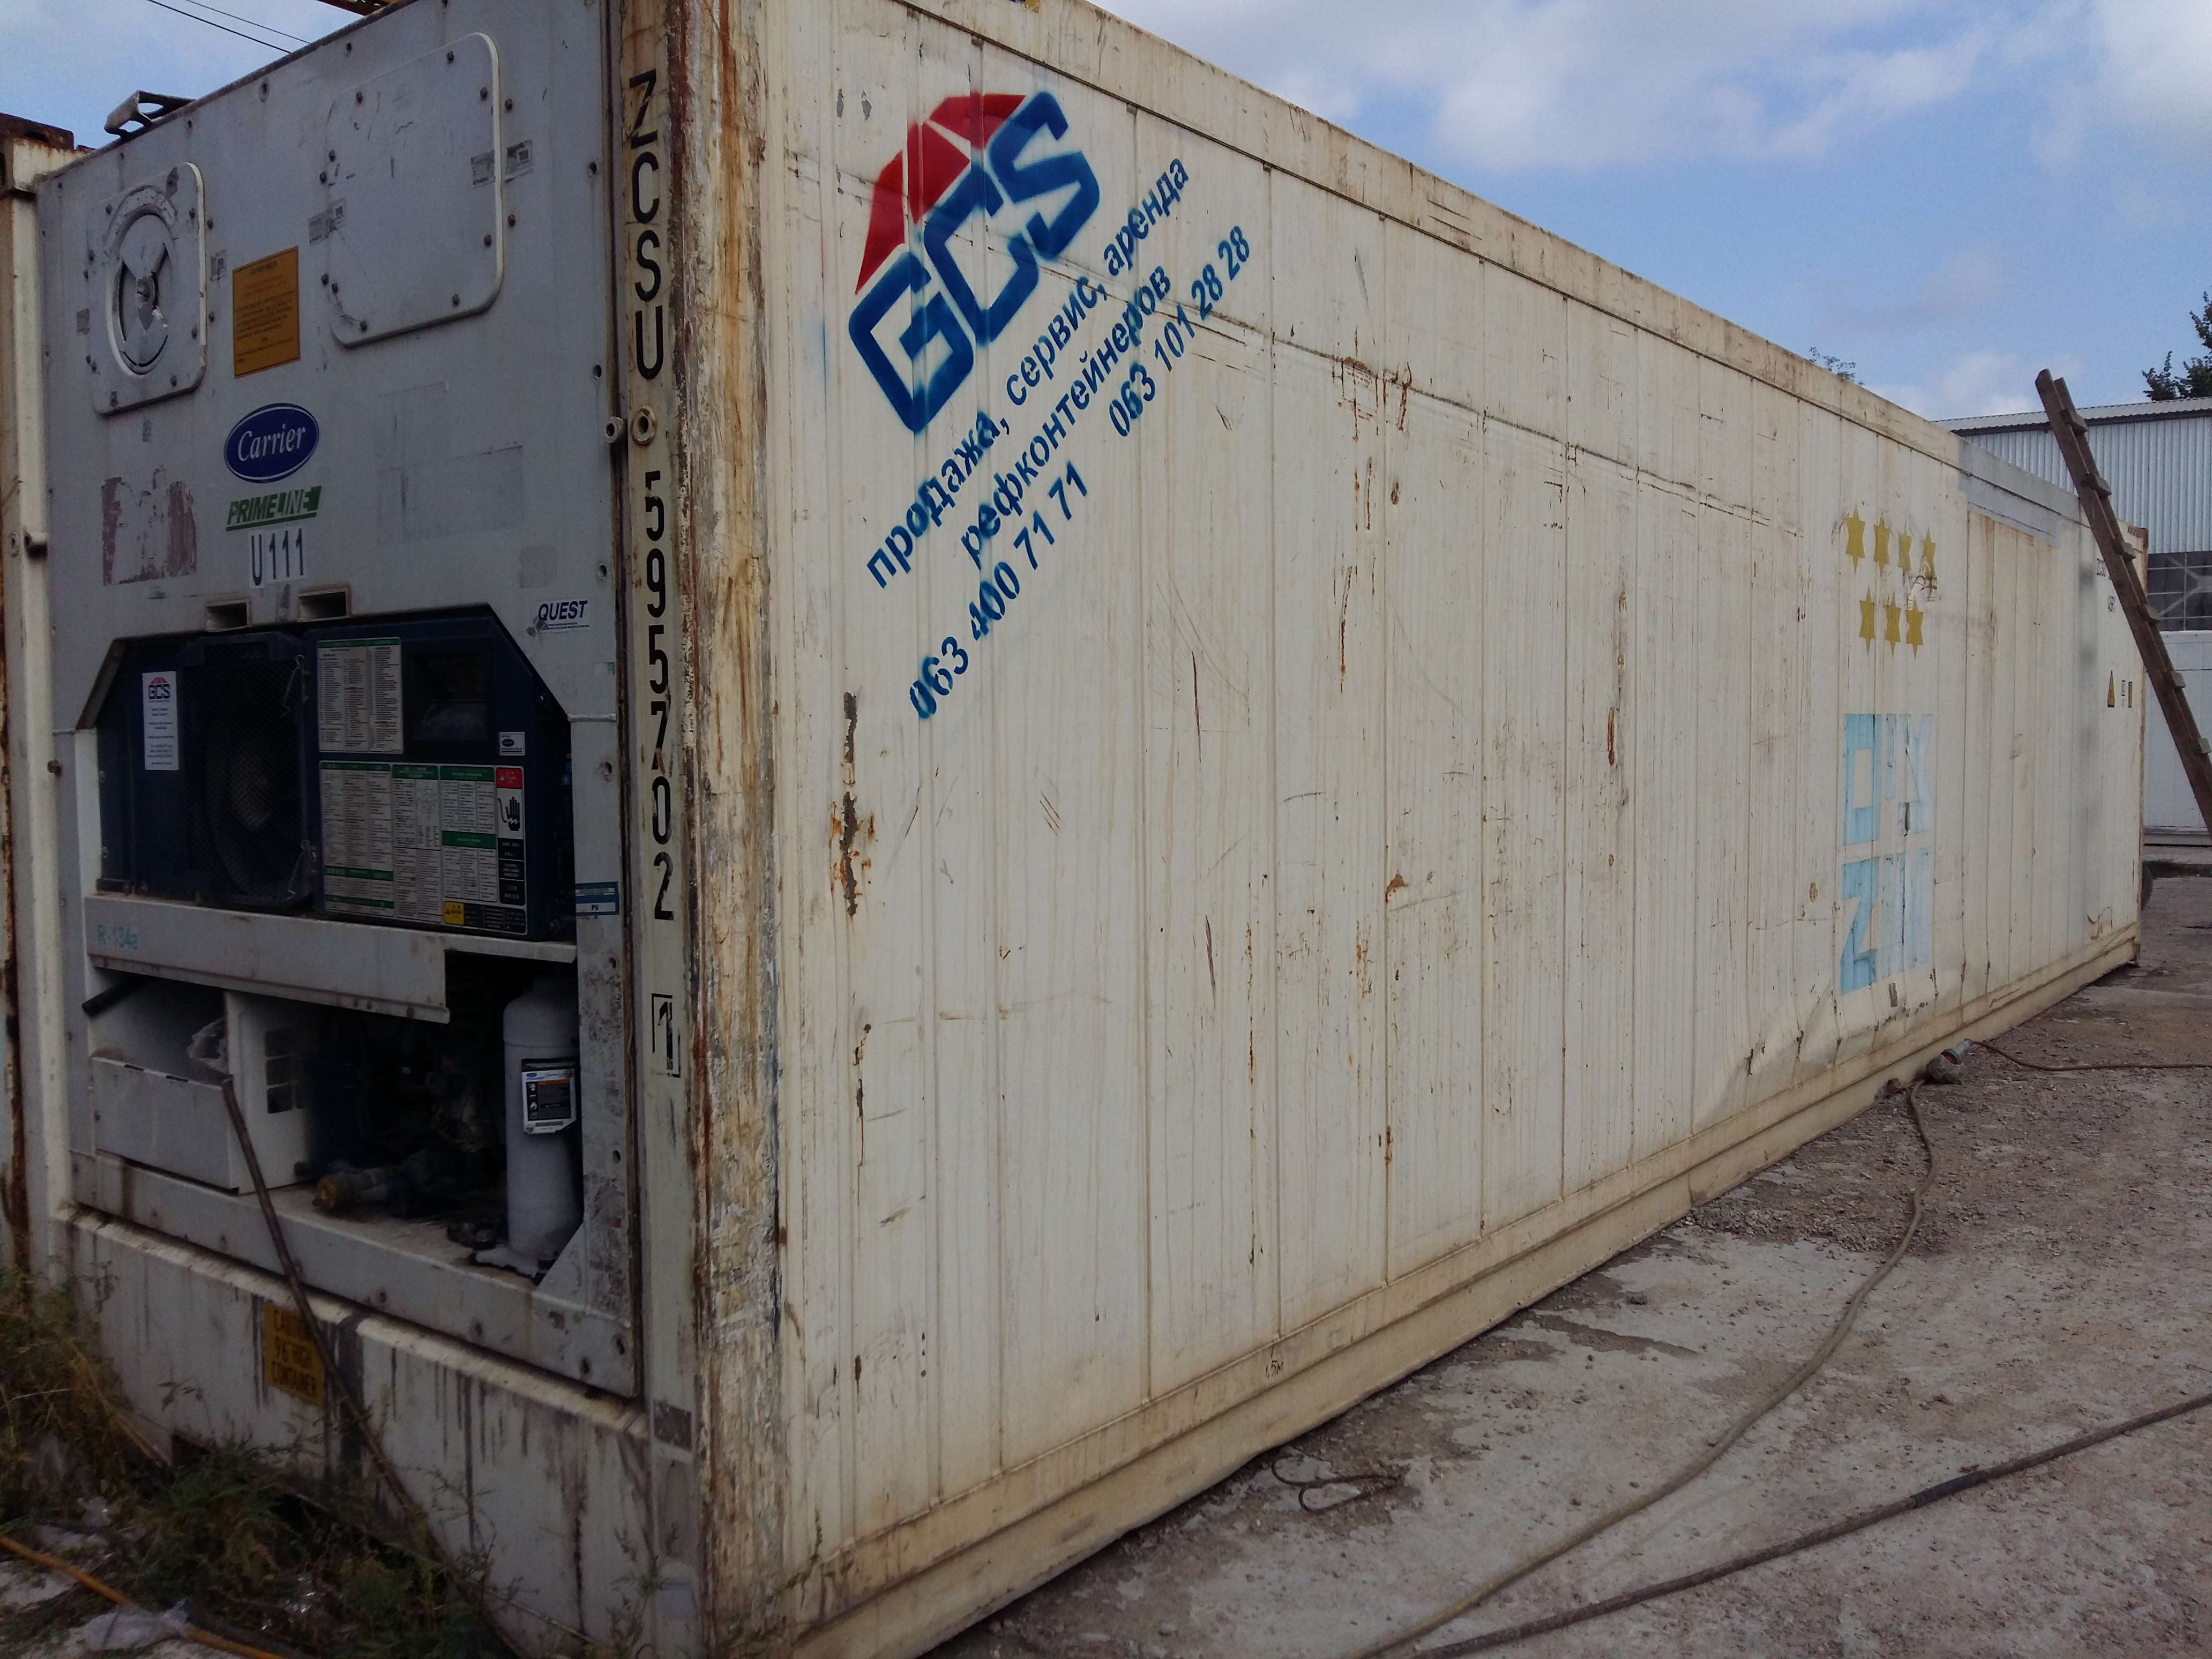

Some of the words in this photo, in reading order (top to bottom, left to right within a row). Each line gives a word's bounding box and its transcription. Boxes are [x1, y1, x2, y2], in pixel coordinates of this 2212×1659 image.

[629, 69, 663, 379] ZCSU
[849, 92, 1100, 433] GCS
[1110, 362, 1156, 437] 063
[1155, 304, 1195, 372] 101
[1191, 264, 1223, 320] 28
[1218, 226, 1249, 280] 28
[237, 423, 305, 462] Carrier
[867, 411, 1010, 588] продажа,
[1006, 276, 1107, 406] сервис,
[1104, 158, 1189, 276] аренда
[961, 266, 1171, 570] рефконтейнеров
[227, 487, 311, 525] PRIMELINE
[251, 528, 303, 586] U111
[539, 600, 588, 621] QUEST
[909, 636, 969, 720] 063
[969, 561, 1020, 641] 400
[1013, 527, 1055, 570] 71
[1048, 459, 1087, 521] 71
[148, 683, 170, 699] GCS
[645, 471, 676, 921] 595702
